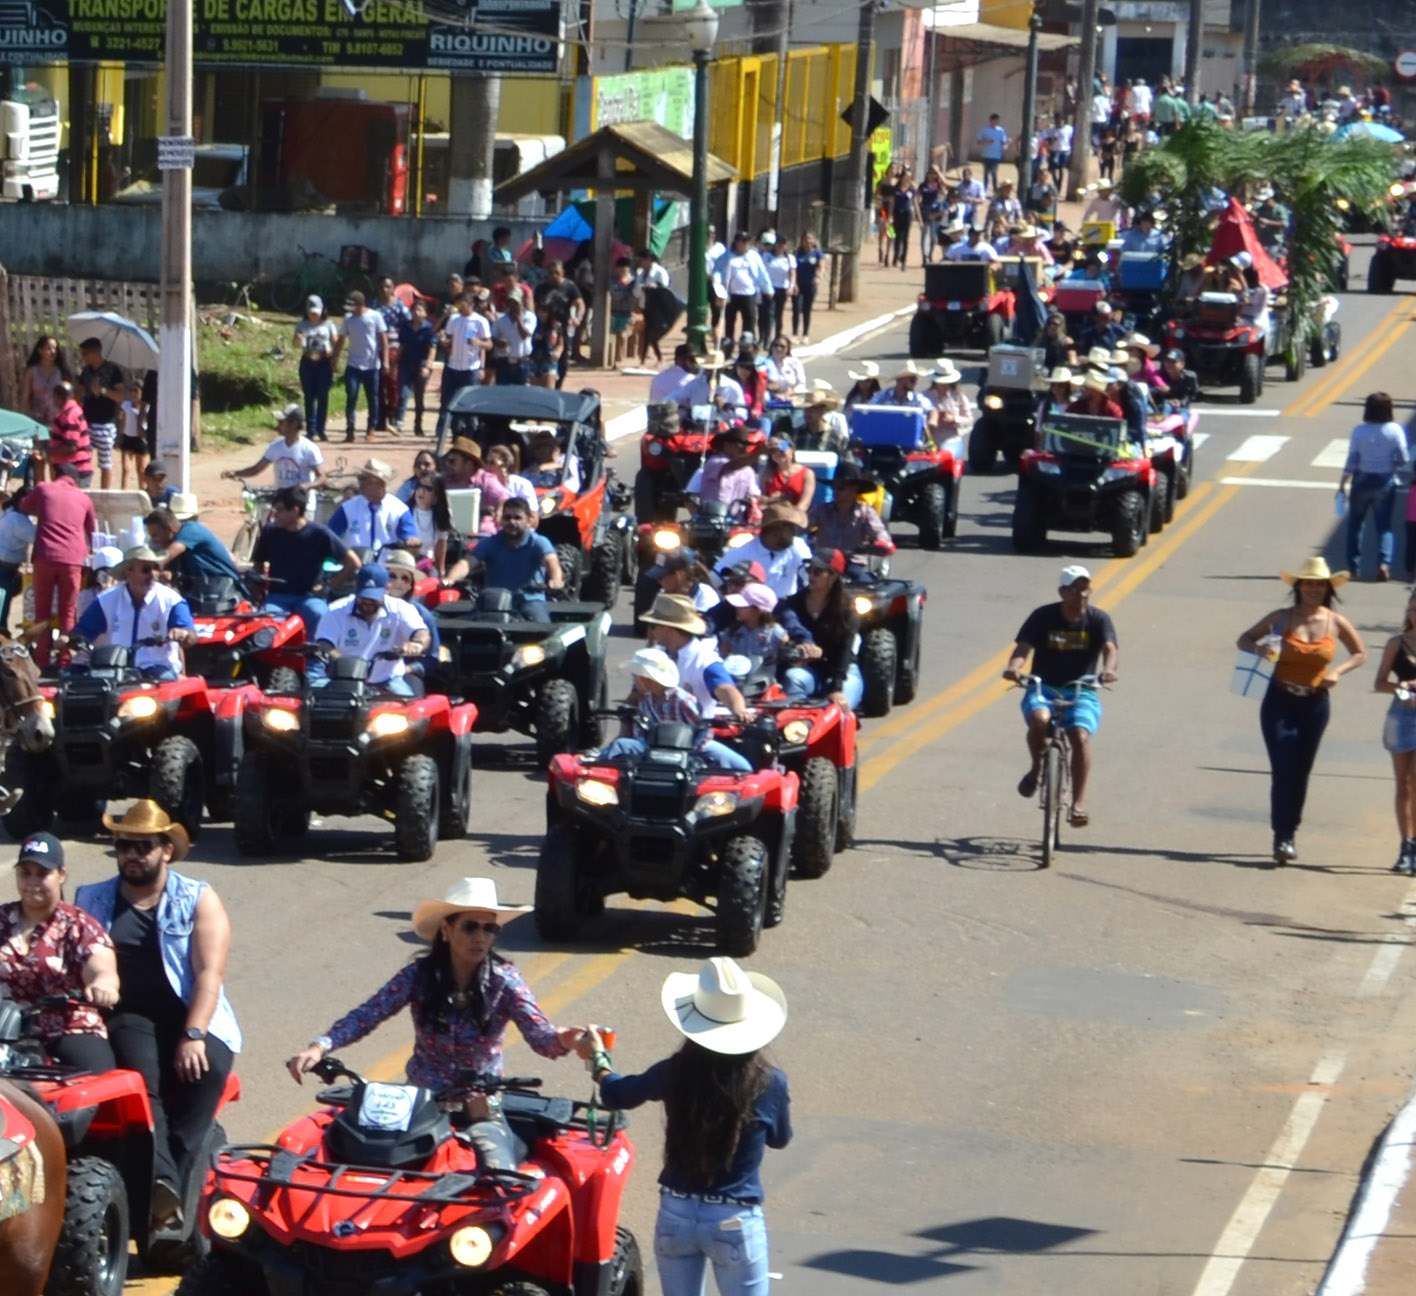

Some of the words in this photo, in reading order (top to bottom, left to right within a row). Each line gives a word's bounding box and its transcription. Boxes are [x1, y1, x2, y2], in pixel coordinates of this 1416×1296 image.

[69, 0, 196, 18] TRANSPOR
[204, 0, 229, 19] DE
[236, 0, 318, 21] CARGAS
[361, 1, 430, 24] GERAL
[430, 34, 551, 52] RIQUINHO
